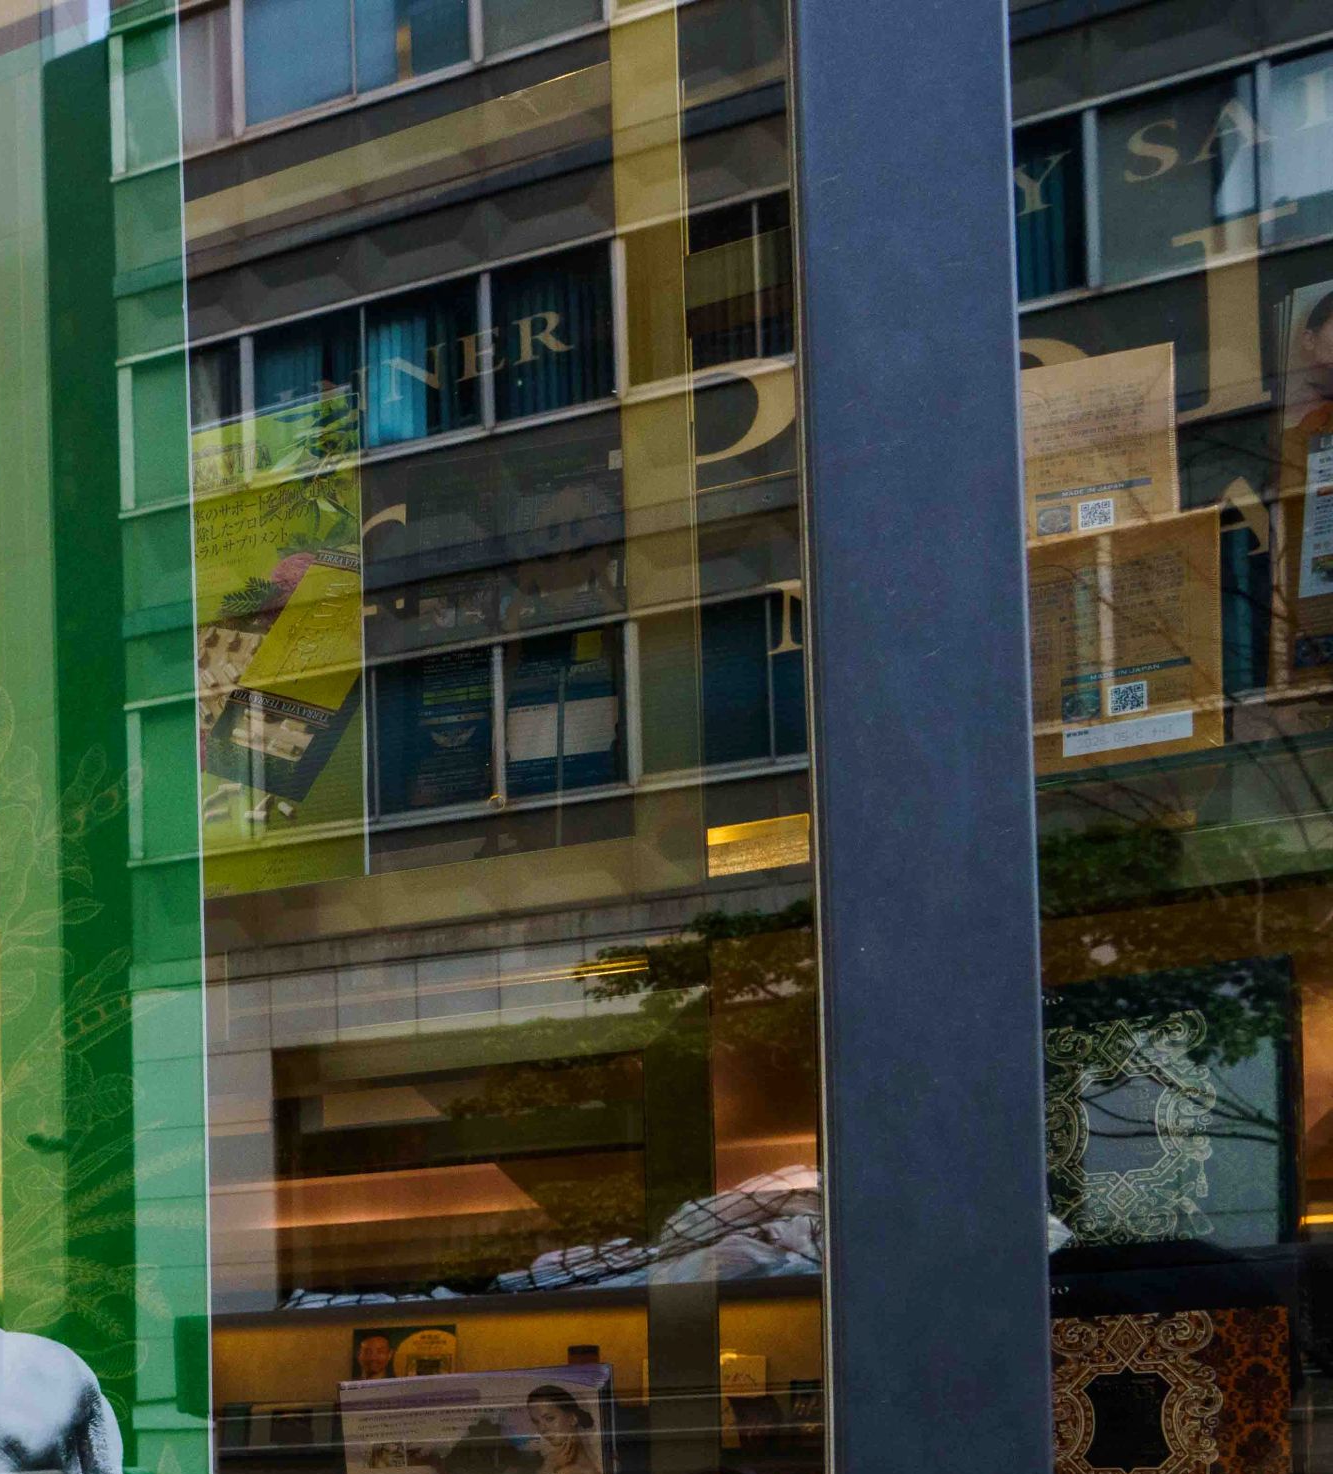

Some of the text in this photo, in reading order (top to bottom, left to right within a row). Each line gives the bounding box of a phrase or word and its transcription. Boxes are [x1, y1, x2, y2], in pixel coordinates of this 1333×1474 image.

[195, 528, 288, 558] ラルサプリメント
